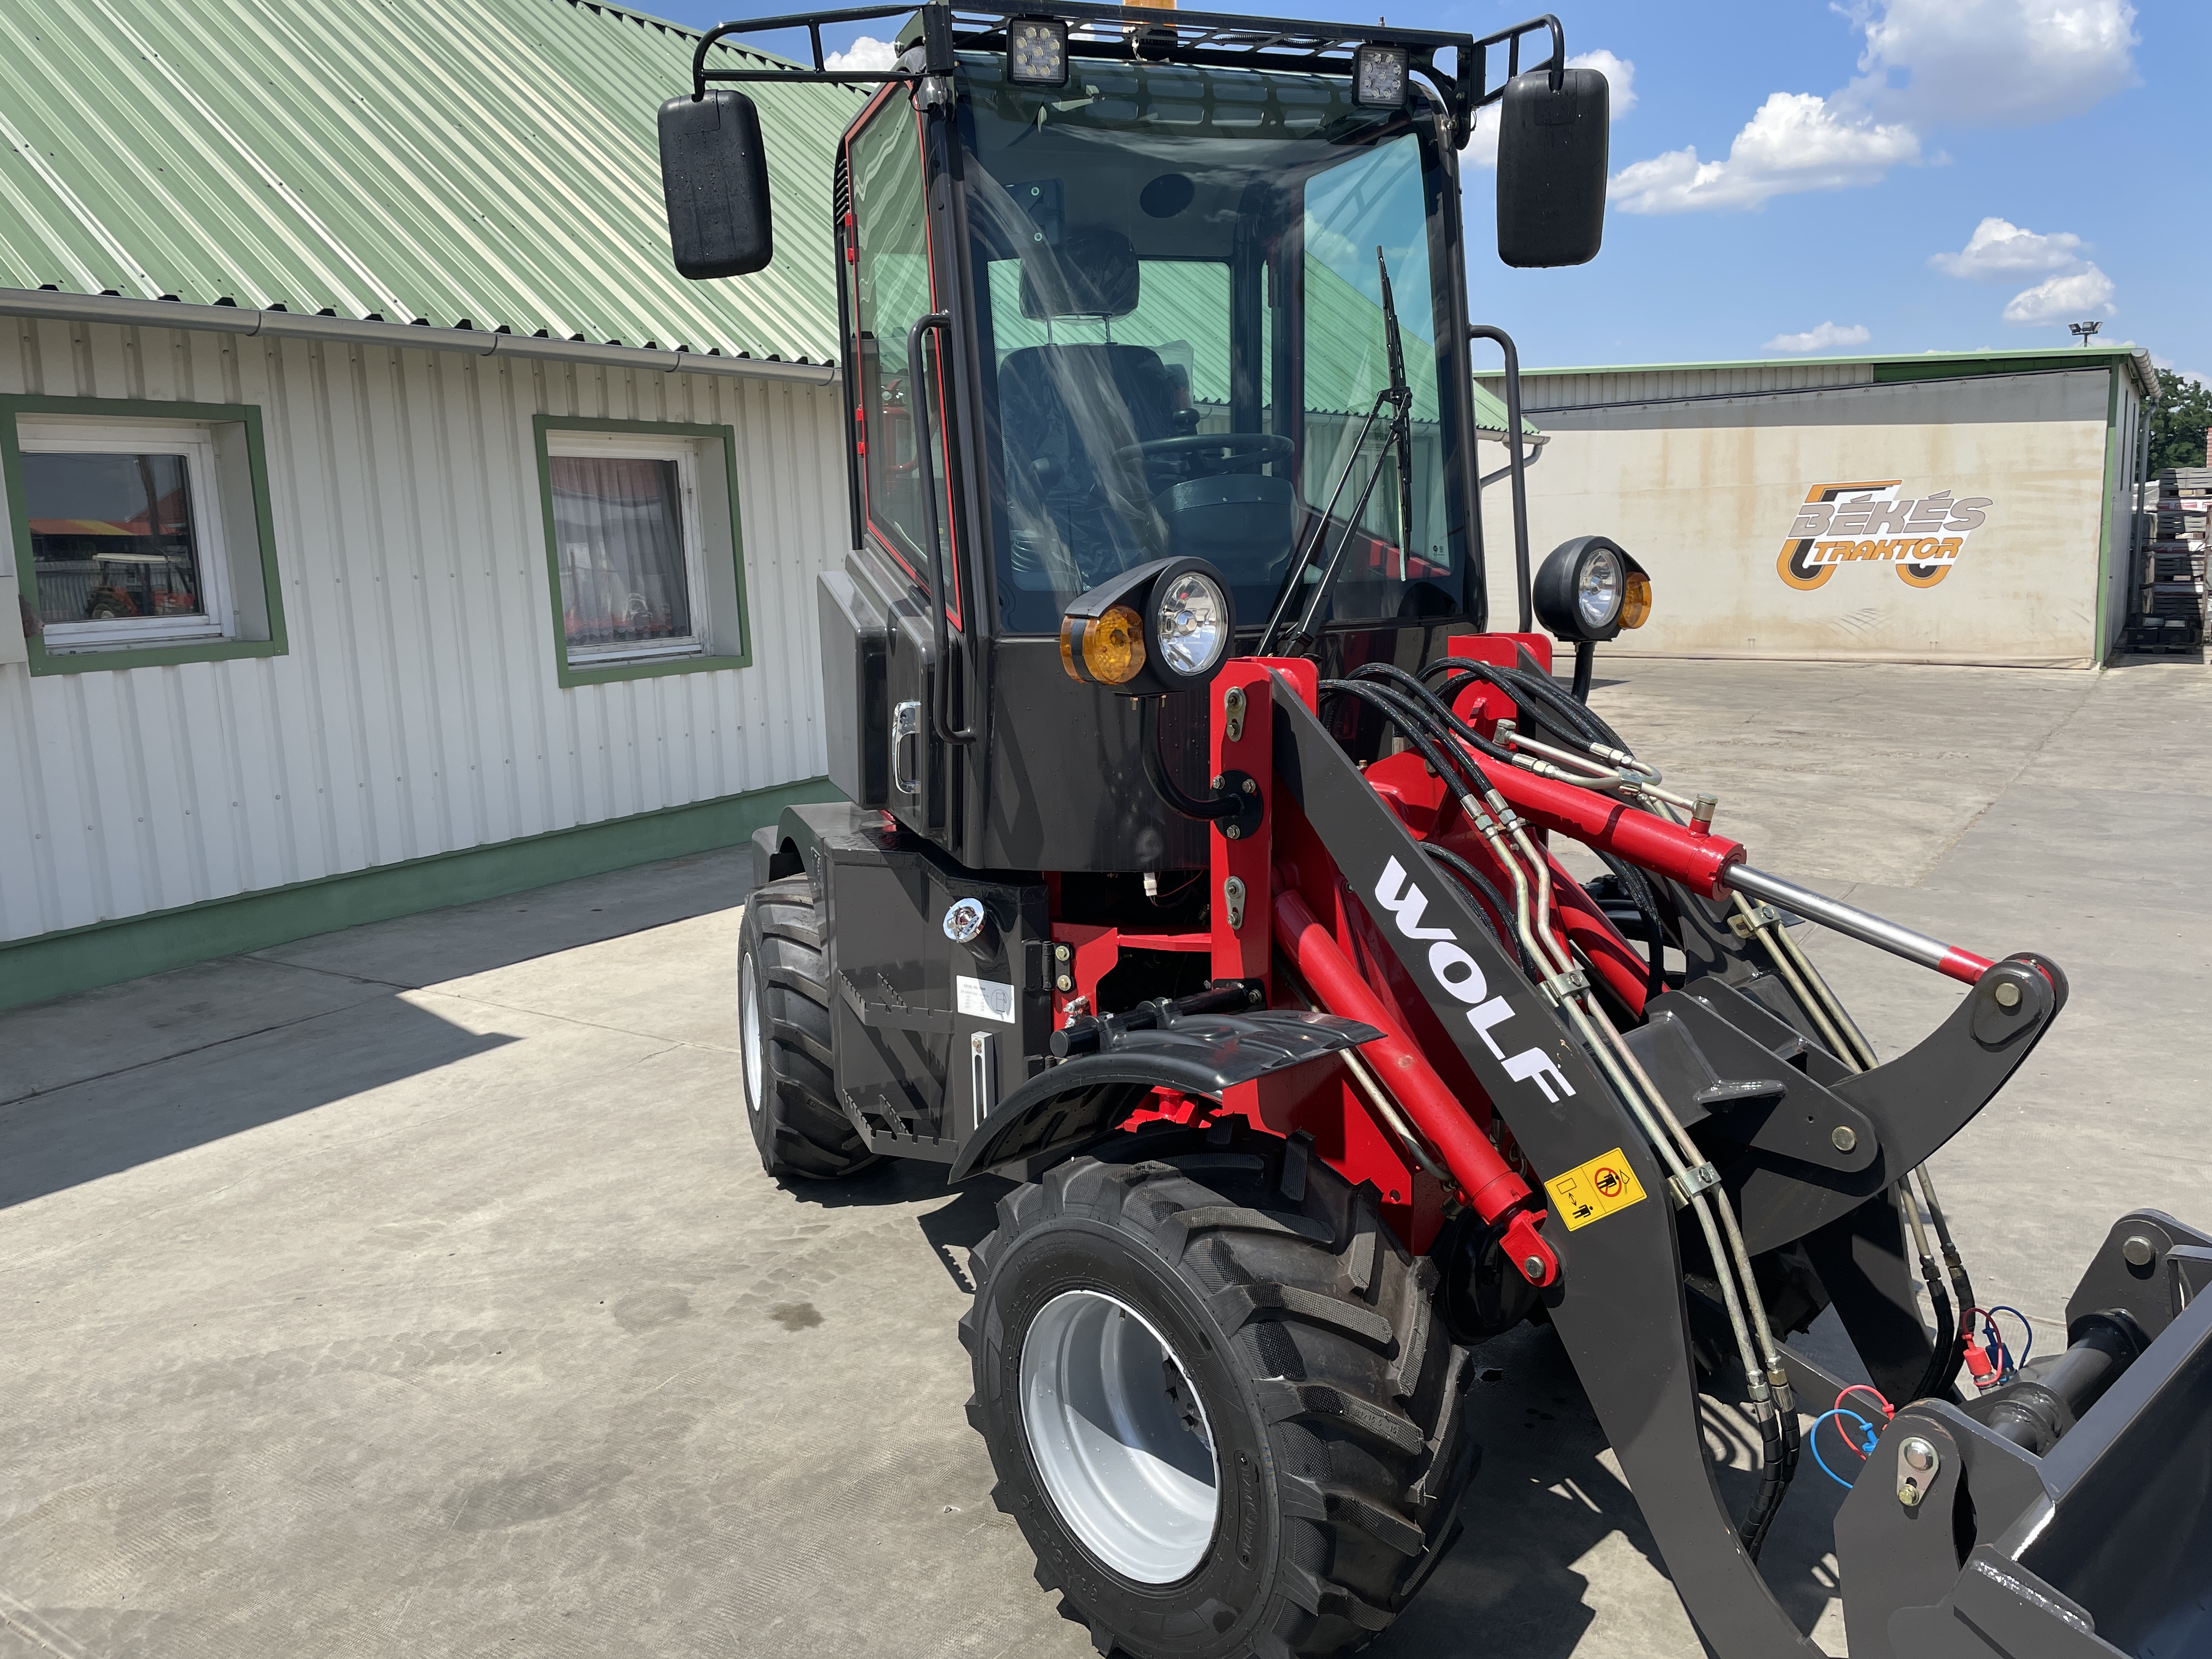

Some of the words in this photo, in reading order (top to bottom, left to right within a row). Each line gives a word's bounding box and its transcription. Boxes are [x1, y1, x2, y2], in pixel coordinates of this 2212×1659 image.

[1788, 490, 1993, 537] BÉKÉS
[1813, 537, 1963, 562] TRAKTOR
[1375, 855, 1576, 1103] WOLF
